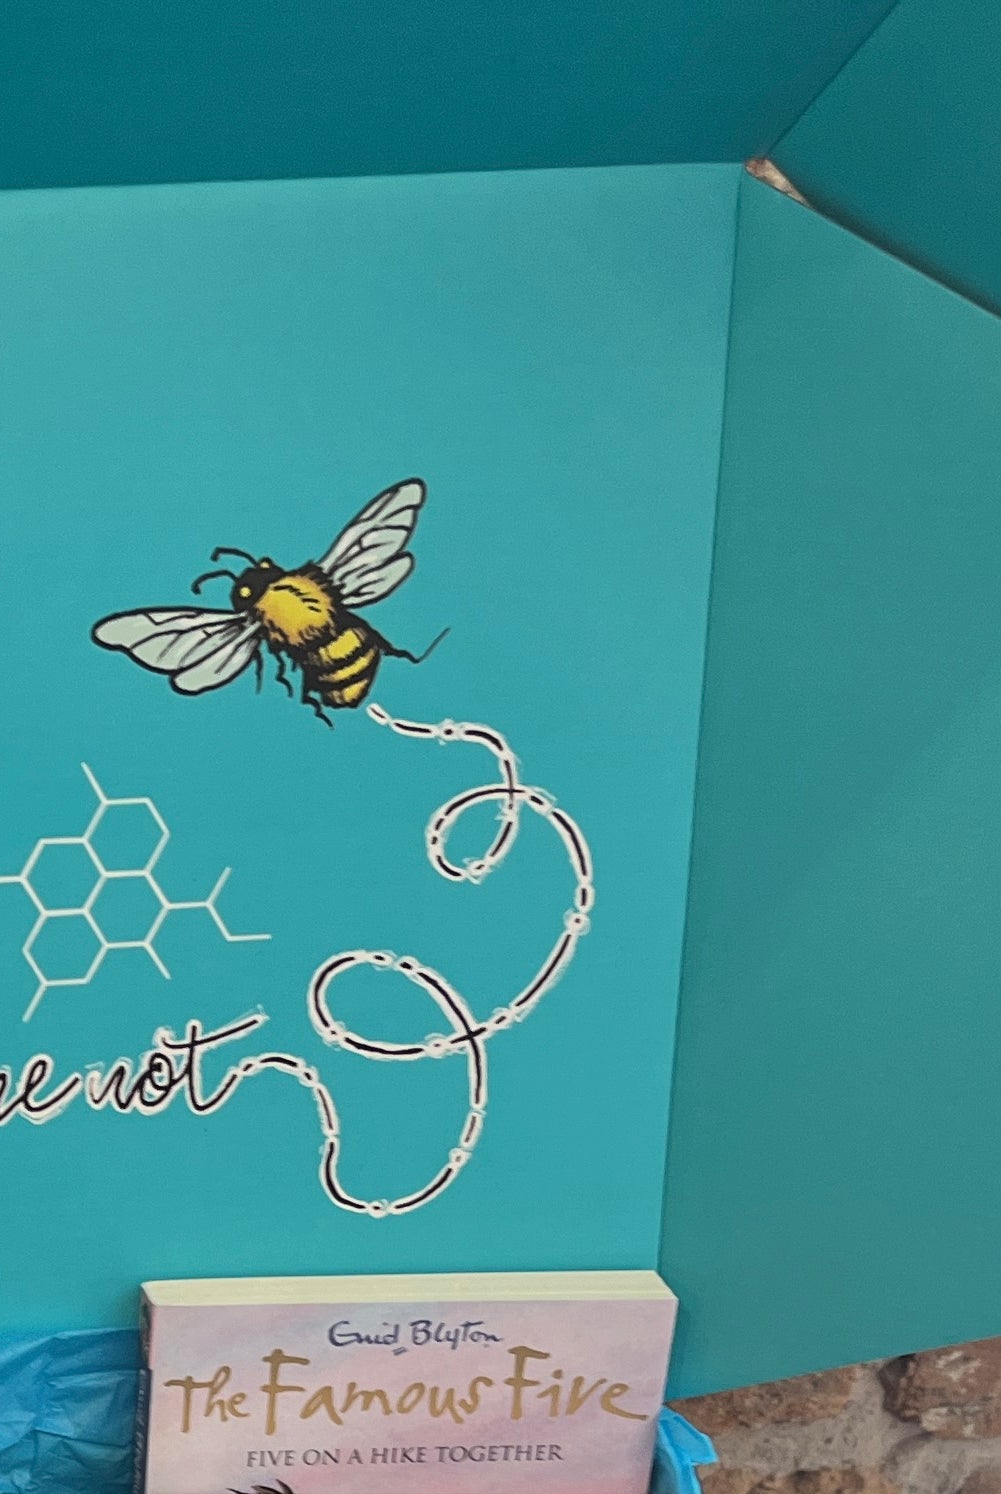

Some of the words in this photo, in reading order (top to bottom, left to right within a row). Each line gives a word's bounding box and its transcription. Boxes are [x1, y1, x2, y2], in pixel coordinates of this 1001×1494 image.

[82, 1002, 272, 1114] not
[327, 1319, 405, 1355] Enid
[410, 1320, 505, 1349] Blyton
[164, 1365, 250, 1433] The
[260, 1348, 494, 1435] Famous
[499, 1345, 650, 1422] Five
[246, 1450, 297, 1468] FIVE
[302, 1448, 340, 1466] ON
[346, 1449, 363, 1465] A
[370, 1446, 428, 1464] HIKE
[434, 1442, 564, 1464] TOGETHER
